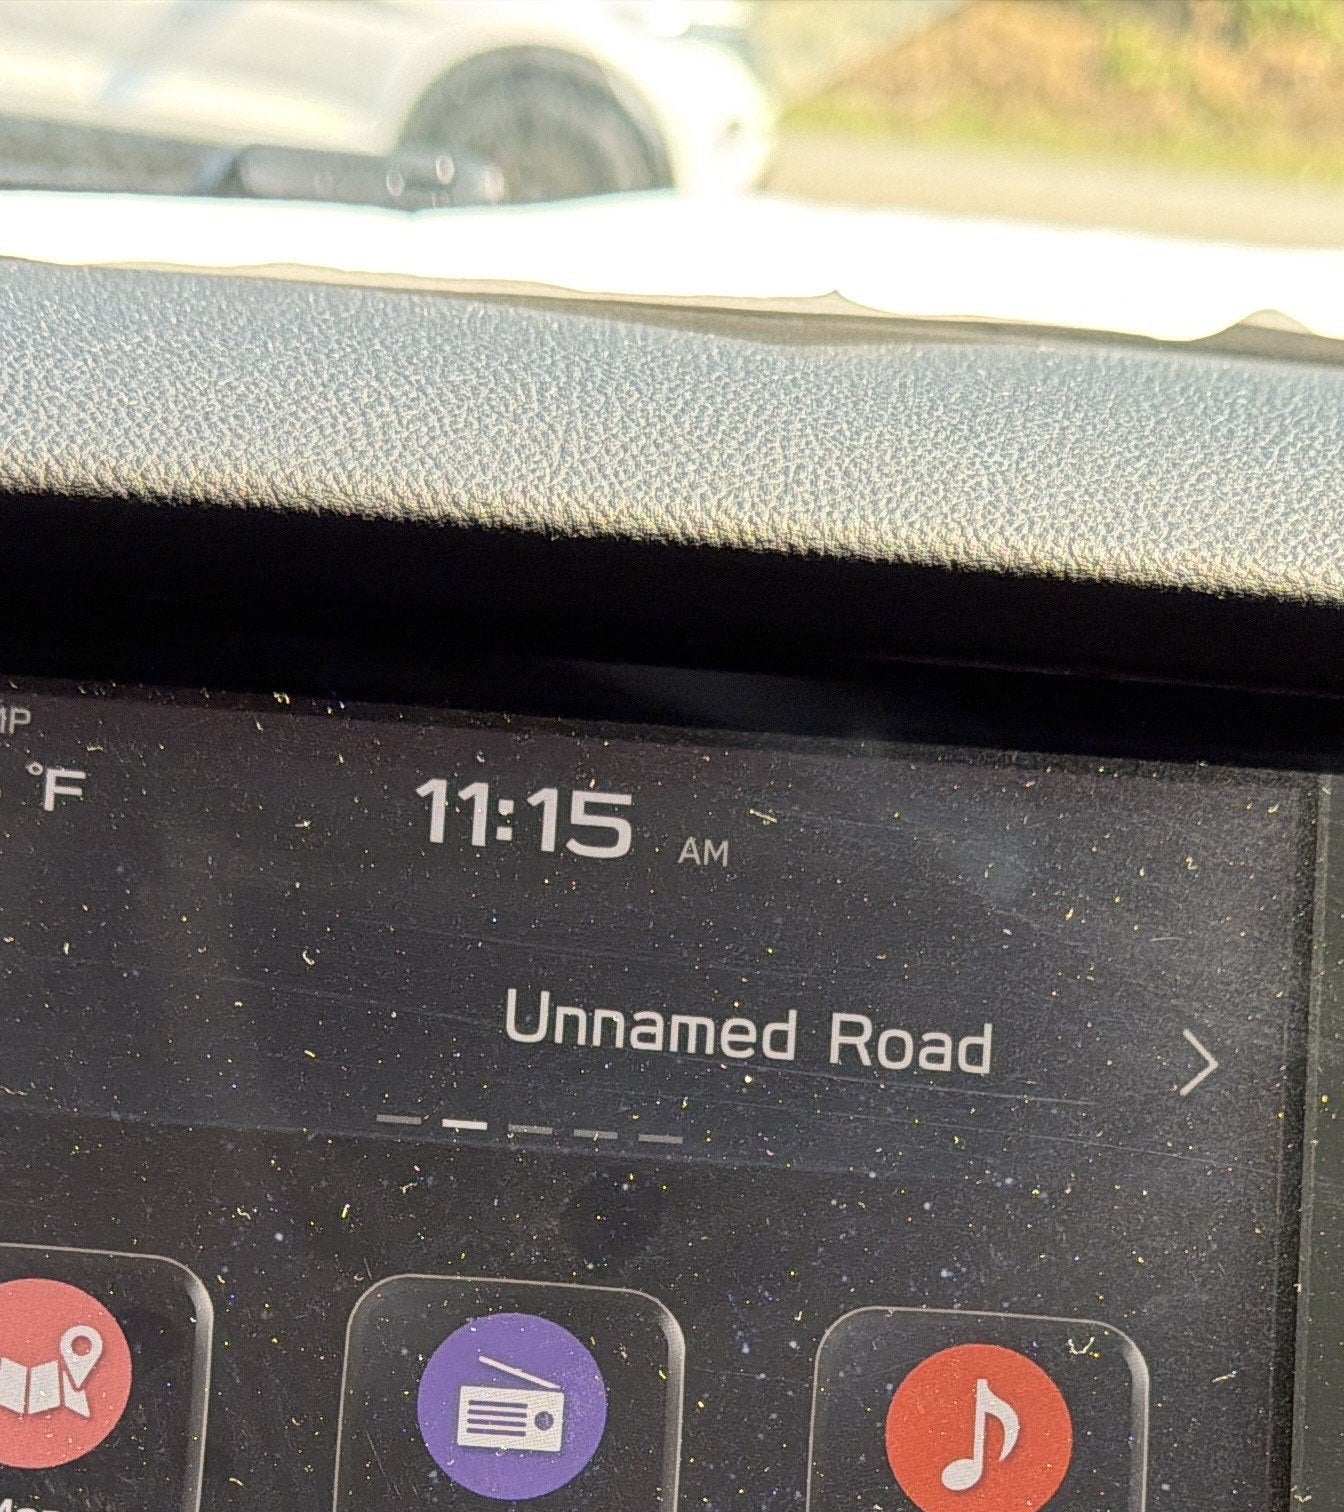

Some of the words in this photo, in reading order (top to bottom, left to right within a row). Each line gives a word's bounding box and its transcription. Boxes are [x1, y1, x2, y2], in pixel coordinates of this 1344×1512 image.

[416, 778, 633, 859] 11:15
[678, 836, 730, 868] AM
[504, 988, 797, 1062] Unnamed
[829, 1012, 993, 1075] Road
